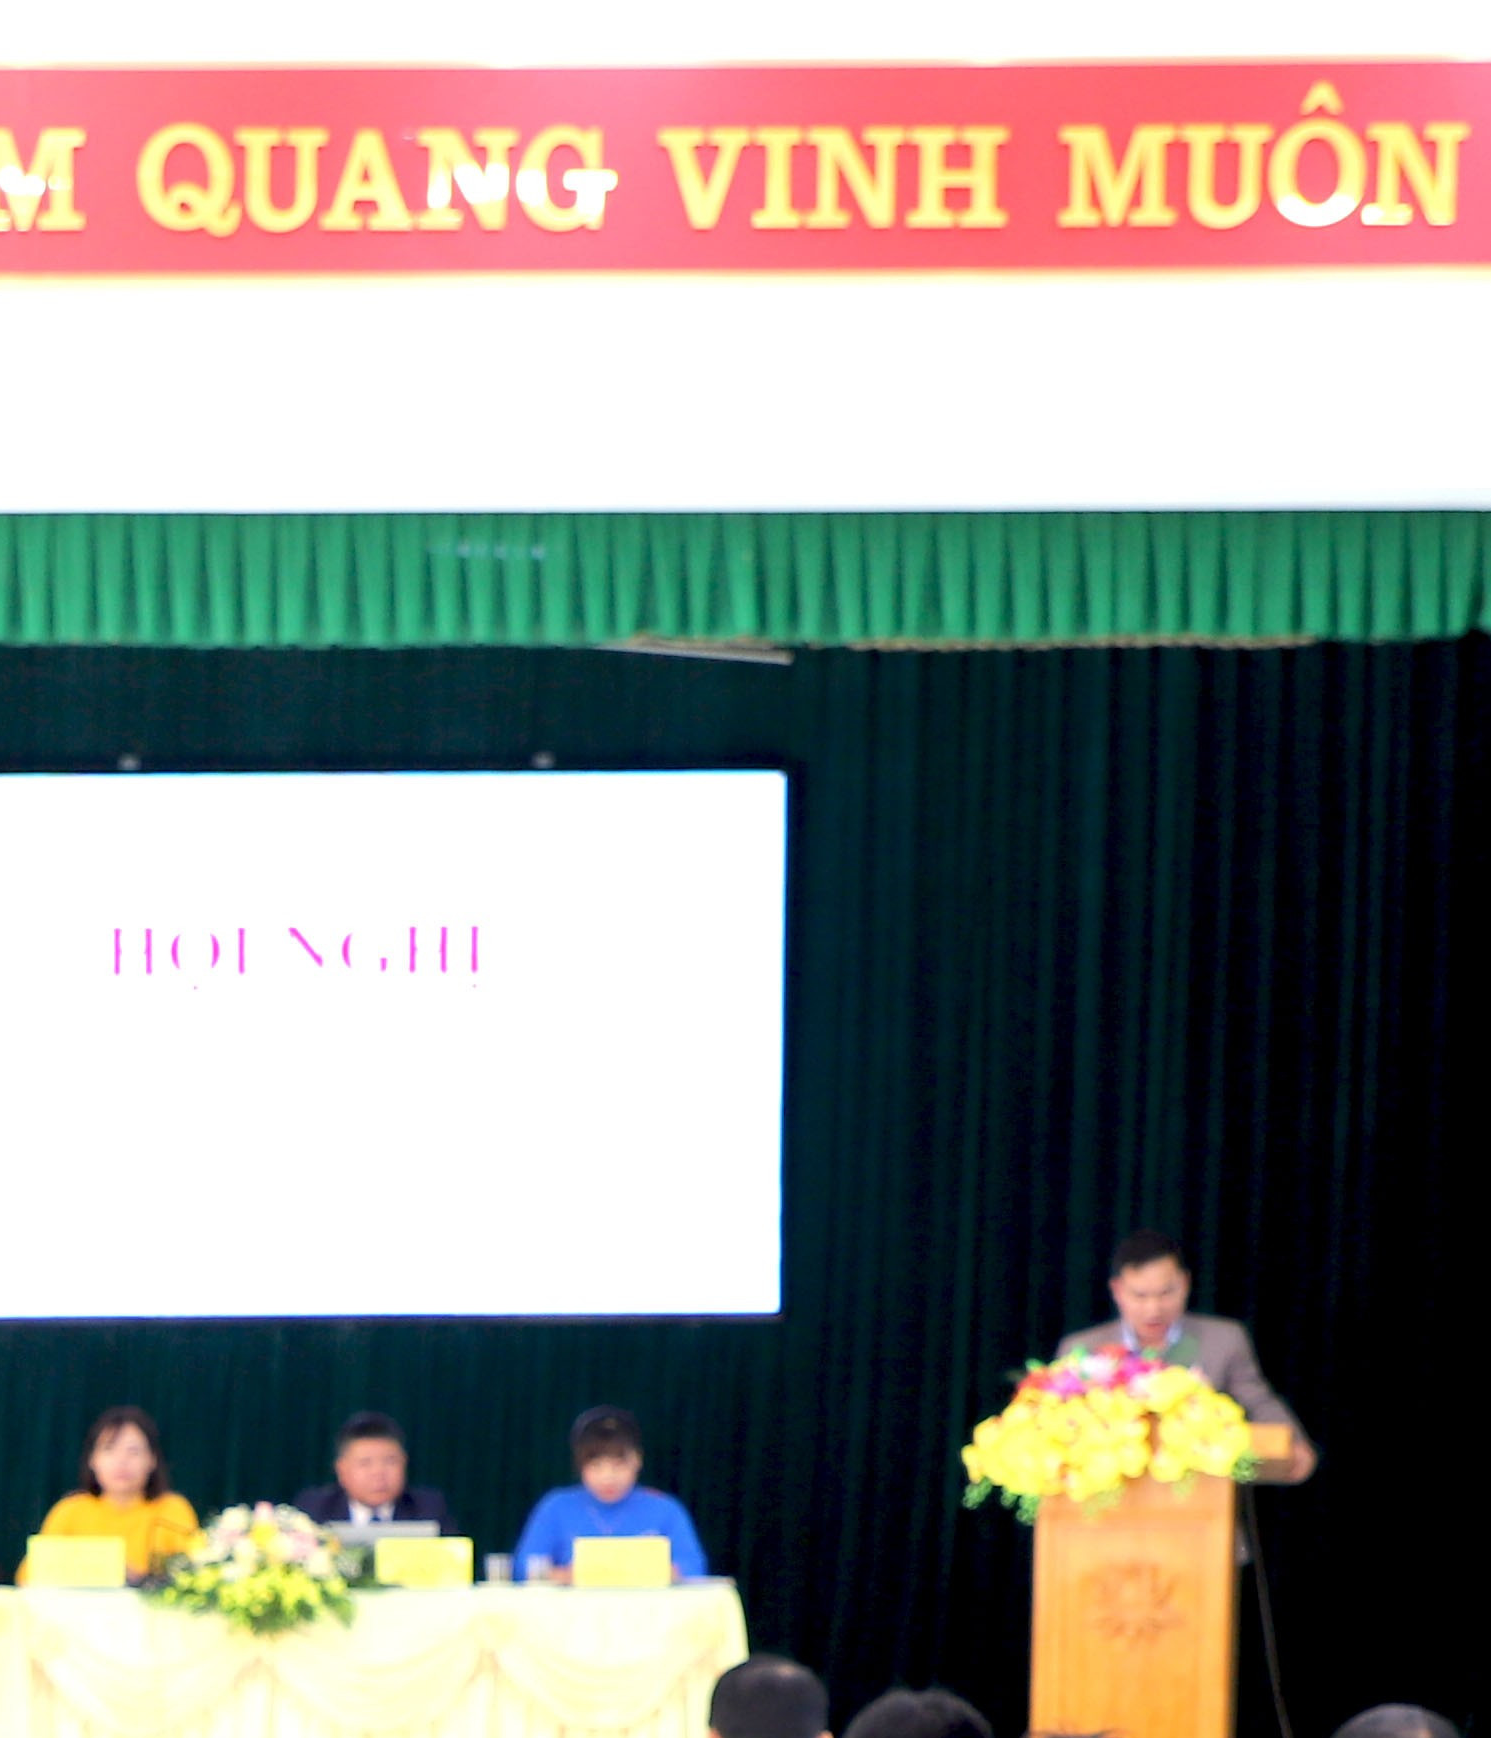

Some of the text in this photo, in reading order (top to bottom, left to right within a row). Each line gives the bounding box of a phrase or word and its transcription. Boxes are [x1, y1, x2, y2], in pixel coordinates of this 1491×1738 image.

[135, 124, 618, 237] QUANG
[658, 121, 1010, 231] VINH
[1059, 84, 1468, 229] MUÔN
